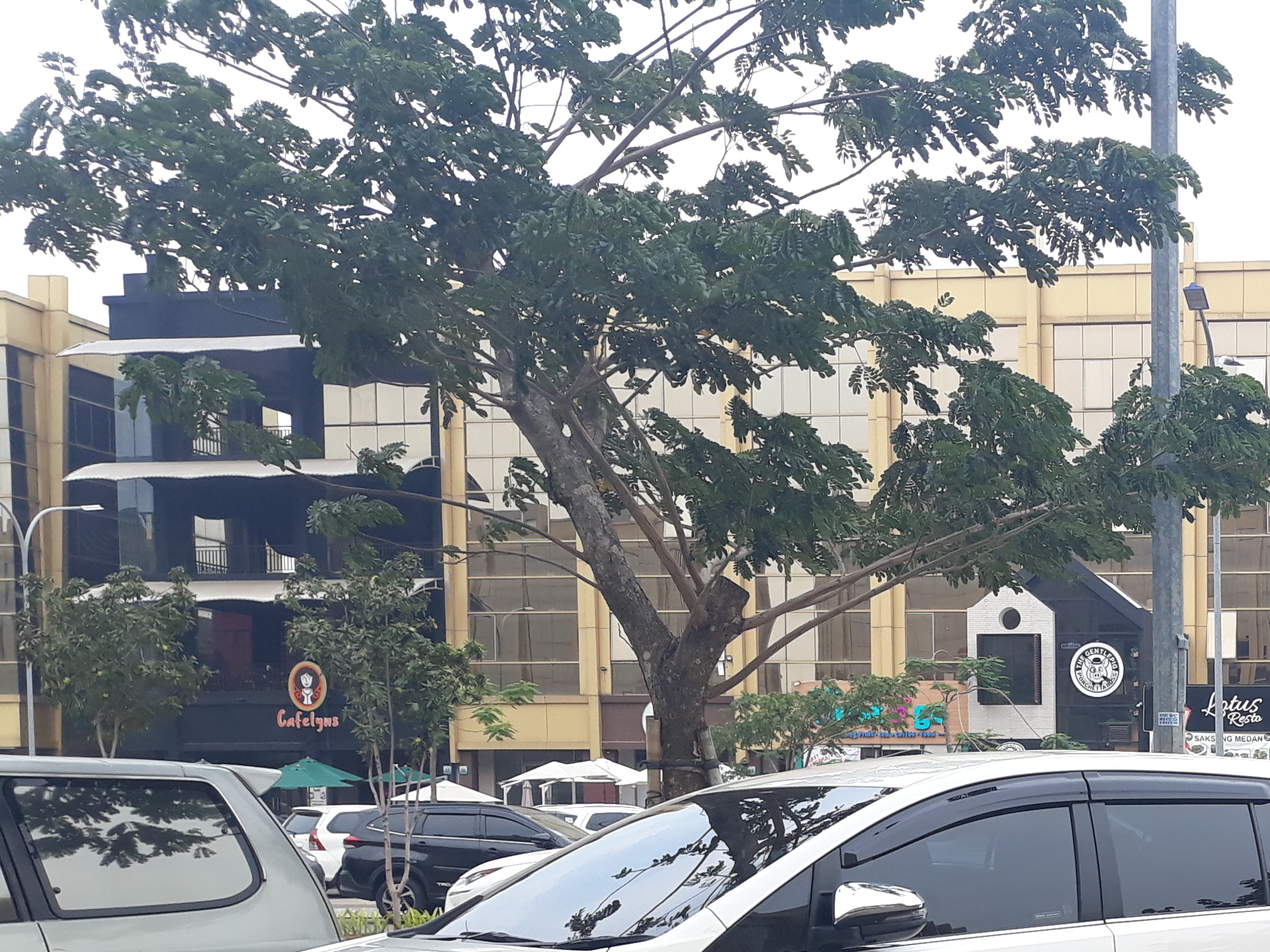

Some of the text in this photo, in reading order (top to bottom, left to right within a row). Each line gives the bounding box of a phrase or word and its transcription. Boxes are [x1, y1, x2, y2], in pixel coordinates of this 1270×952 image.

[1076, 648, 1118, 670] THE GENTLEPIG
[277, 709, 339, 732] Cafelyns
[1227, 713, 1263, 728] Resto
[1194, 735, 1263, 743] SAKSNG MEDAN
